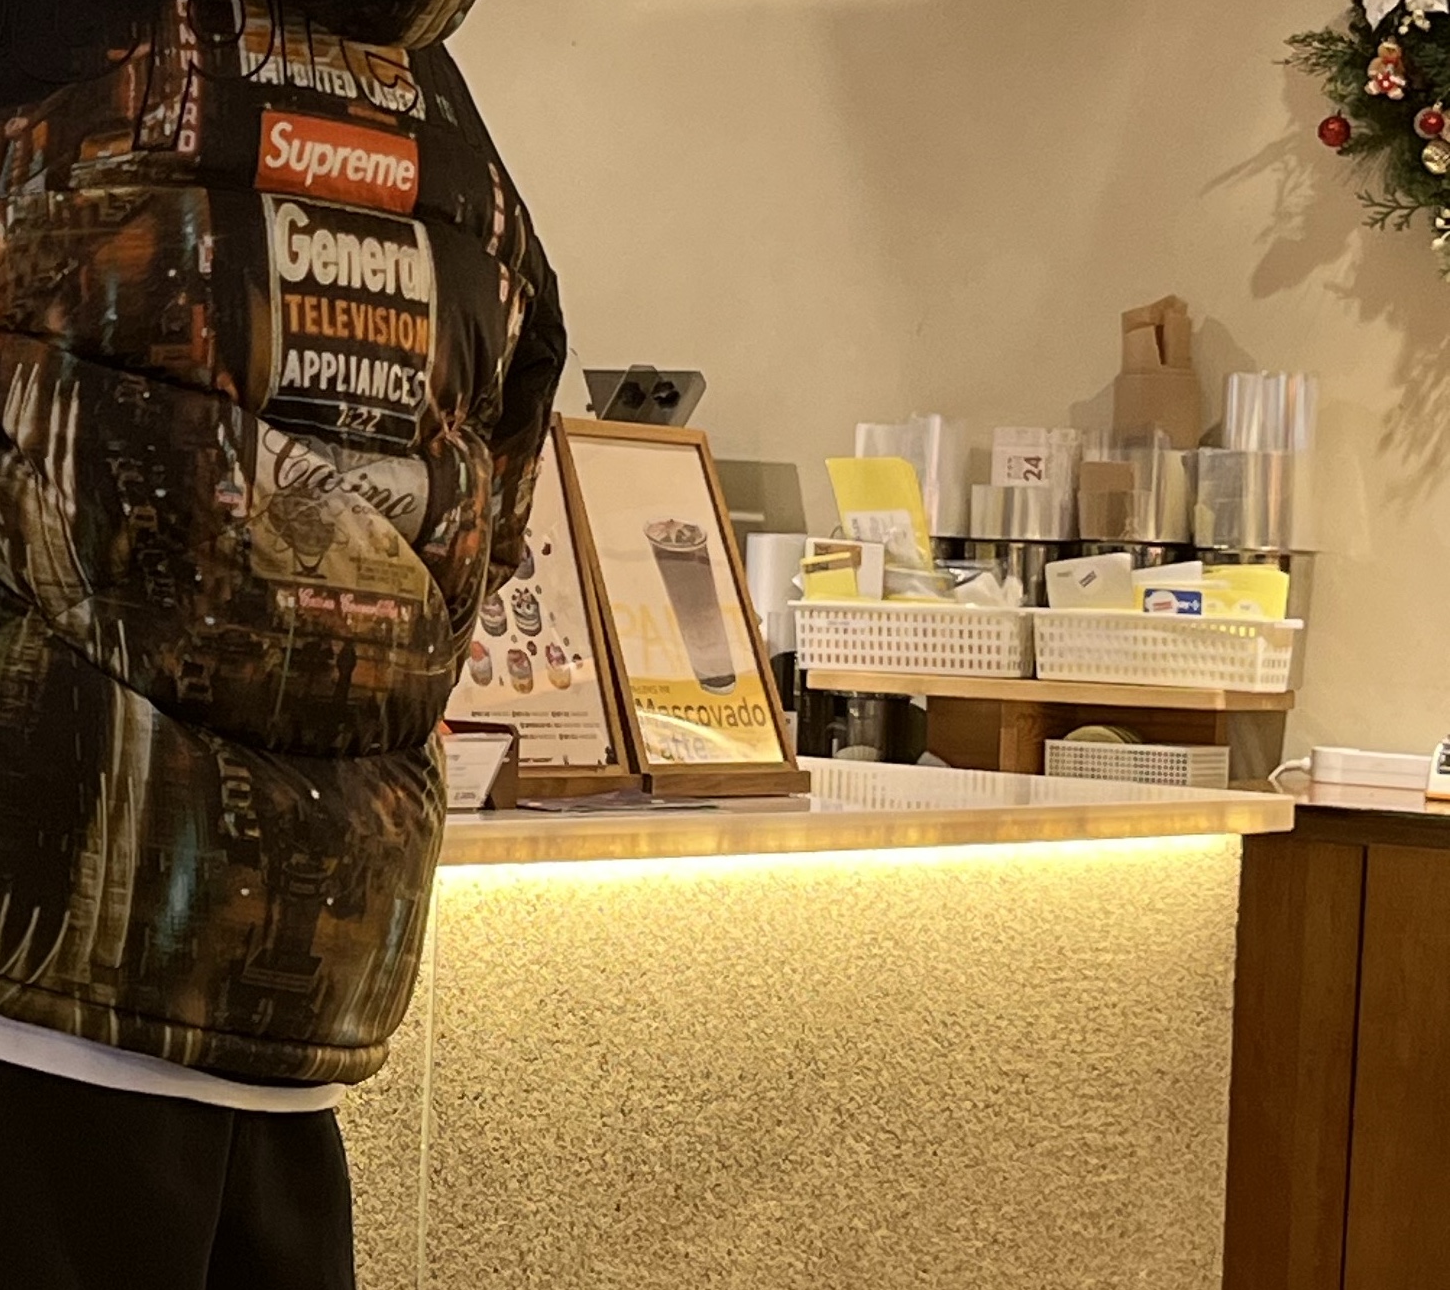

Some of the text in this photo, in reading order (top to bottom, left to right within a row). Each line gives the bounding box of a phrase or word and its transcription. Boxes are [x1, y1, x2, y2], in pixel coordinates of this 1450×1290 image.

[265, 121, 415, 191] Supreme
[275, 202, 430, 303] General
[284, 294, 429, 355] TELEVISION
[281, 349, 426, 407] APPLIANCES
[1023, 456, 1042, 481] 24
